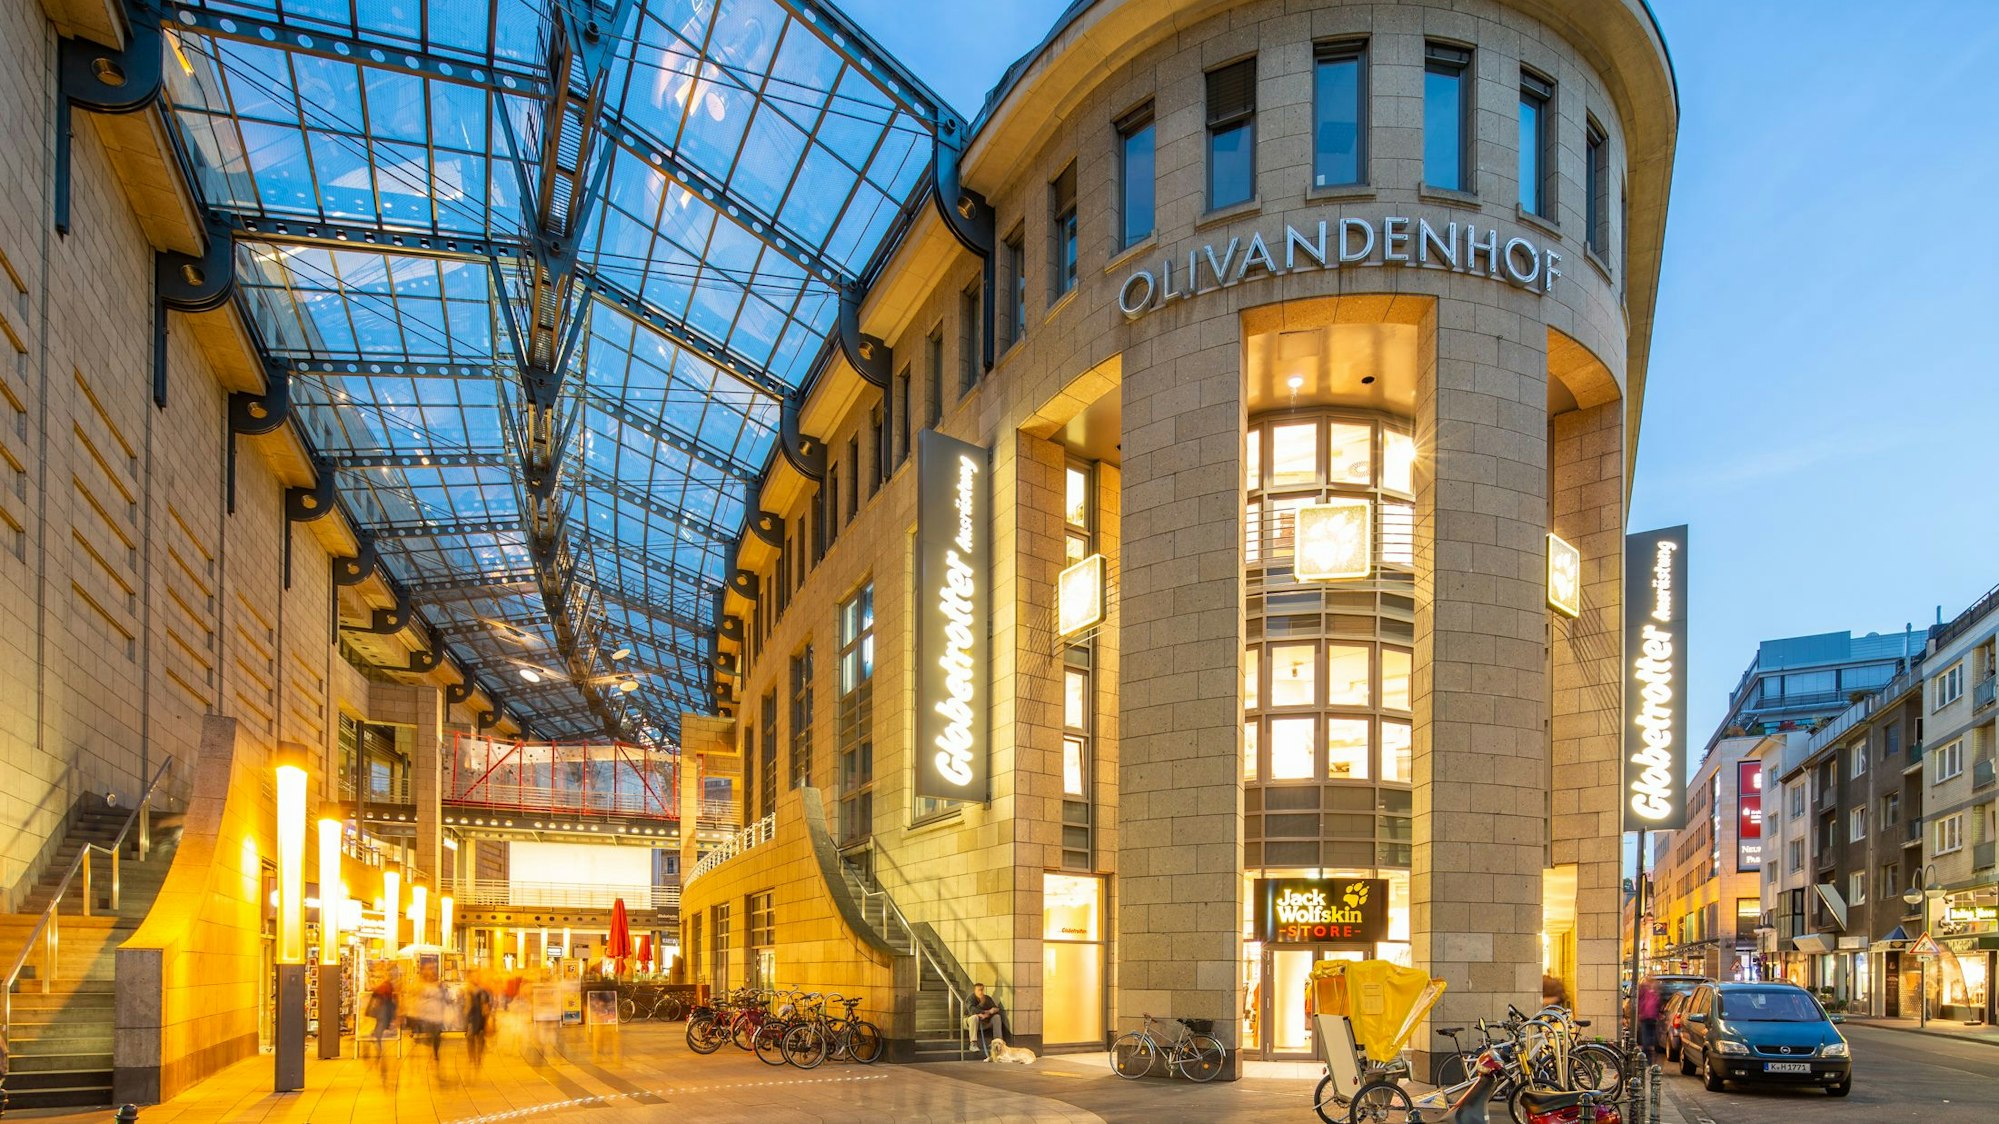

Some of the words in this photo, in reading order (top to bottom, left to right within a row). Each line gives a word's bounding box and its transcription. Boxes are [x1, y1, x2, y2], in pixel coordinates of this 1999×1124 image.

[1119, 216, 1563, 320] OLIVANDENHOF
[935, 550, 974, 786] Globetrotter
[1631, 624, 1673, 819] Globetrotter
[1276, 888, 1327, 906] Jack
[1276, 905, 1362, 923] Wolfskin
